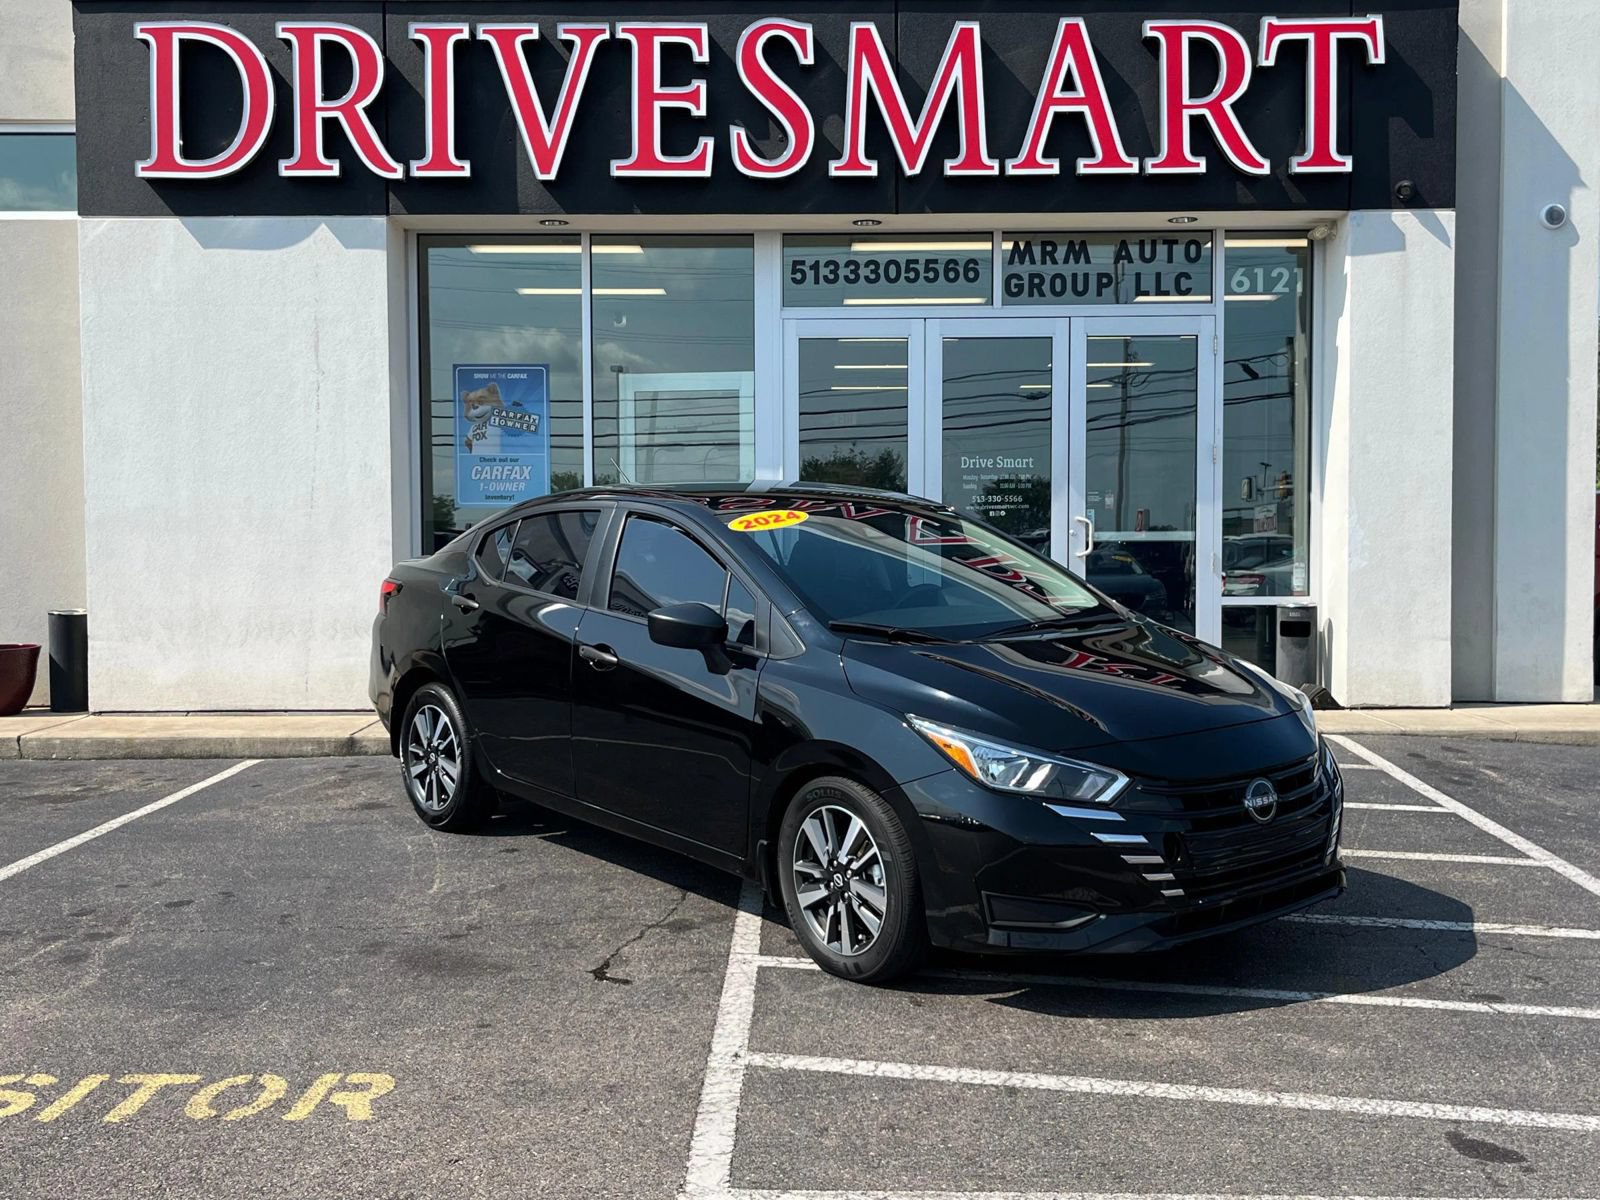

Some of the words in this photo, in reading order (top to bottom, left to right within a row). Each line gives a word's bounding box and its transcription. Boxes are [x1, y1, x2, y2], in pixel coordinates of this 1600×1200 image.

[134, 14, 1386, 183] DRIVESMART
[1007, 239, 1092, 266] MRM
[1113, 239, 1202, 264] AUTO
[790, 258, 980, 285] 5133305566
[1004, 272, 1114, 298] GROUP
[1135, 271, 1193, 296] LLC
[493, 409, 540, 425] CARFAX
[960, 456, 994, 469] Drive
[996, 456, 1034, 468] Smart
[471, 465, 533, 480] CARFAX
[480, 481, 526, 492] 1-OWNER
[972, 495, 1023, 503] 513-330-5566
[738, 511, 801, 530] 2024
[1244, 793, 1277, 807] NISSAN
